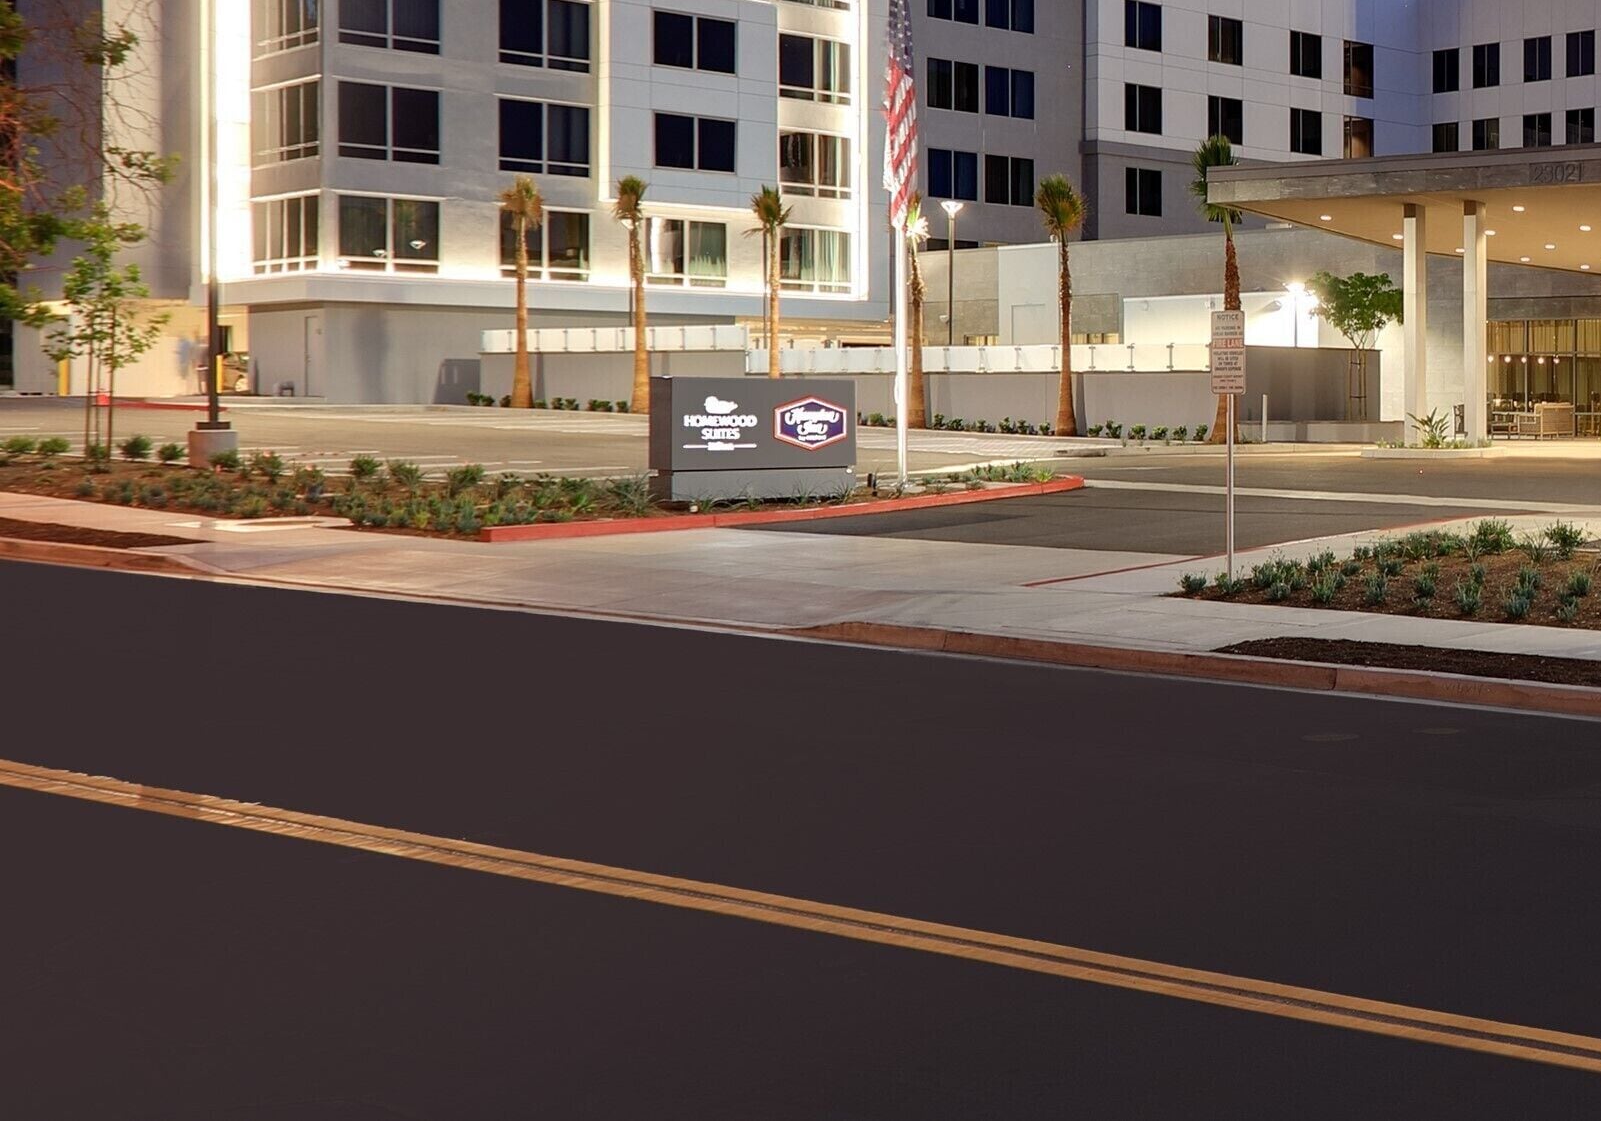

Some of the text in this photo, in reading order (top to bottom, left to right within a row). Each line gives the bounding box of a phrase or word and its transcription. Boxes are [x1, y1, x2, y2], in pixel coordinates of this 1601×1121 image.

[1212, 338, 1243, 348] FIRE LANE
[683, 415, 758, 428] HOMEWOOD
[701, 427, 740, 440] SUITES
